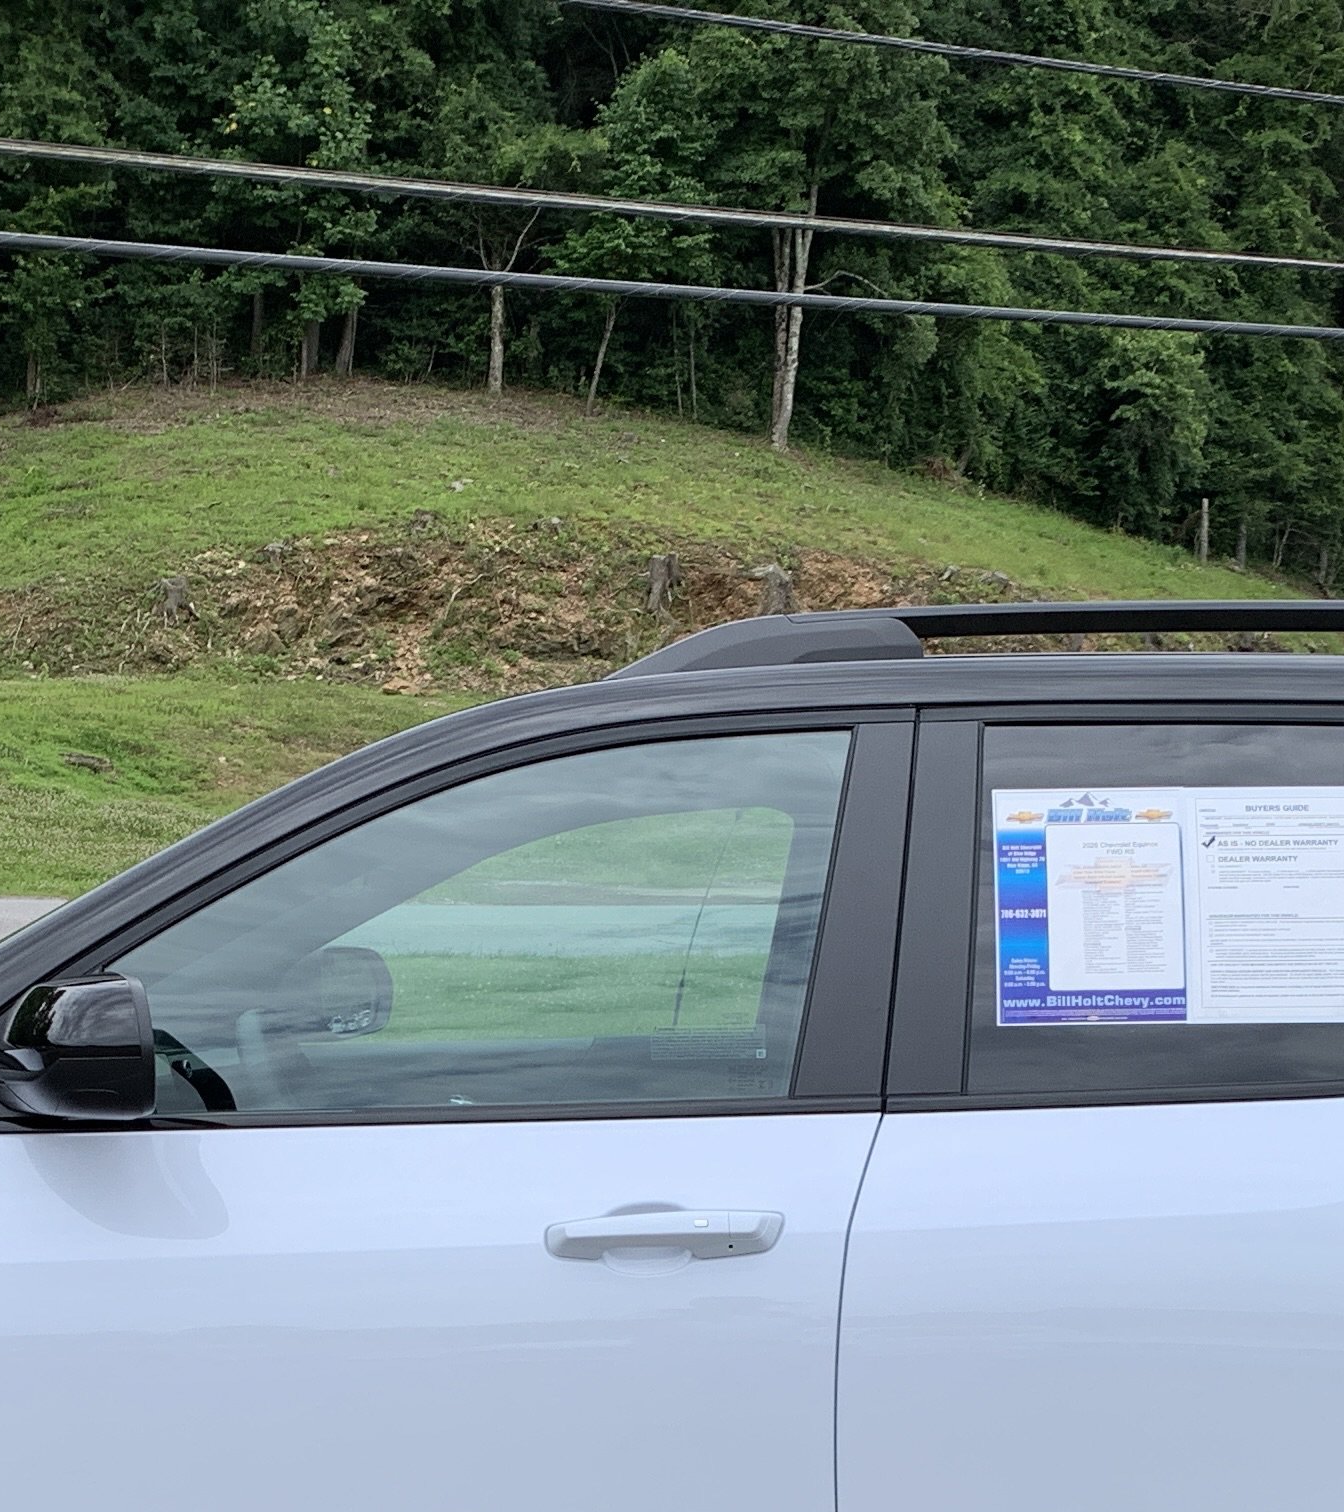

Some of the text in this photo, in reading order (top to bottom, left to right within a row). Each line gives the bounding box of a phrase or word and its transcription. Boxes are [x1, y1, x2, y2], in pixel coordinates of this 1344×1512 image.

[1245, 804, 1310, 813] BUYERS GUIDE
[1258, 839, 1291, 847] DEALER
[1251, 855, 1298, 863] WARRANTY
[1003, 994, 1186, 1008] www.BillHoltChevy.com
